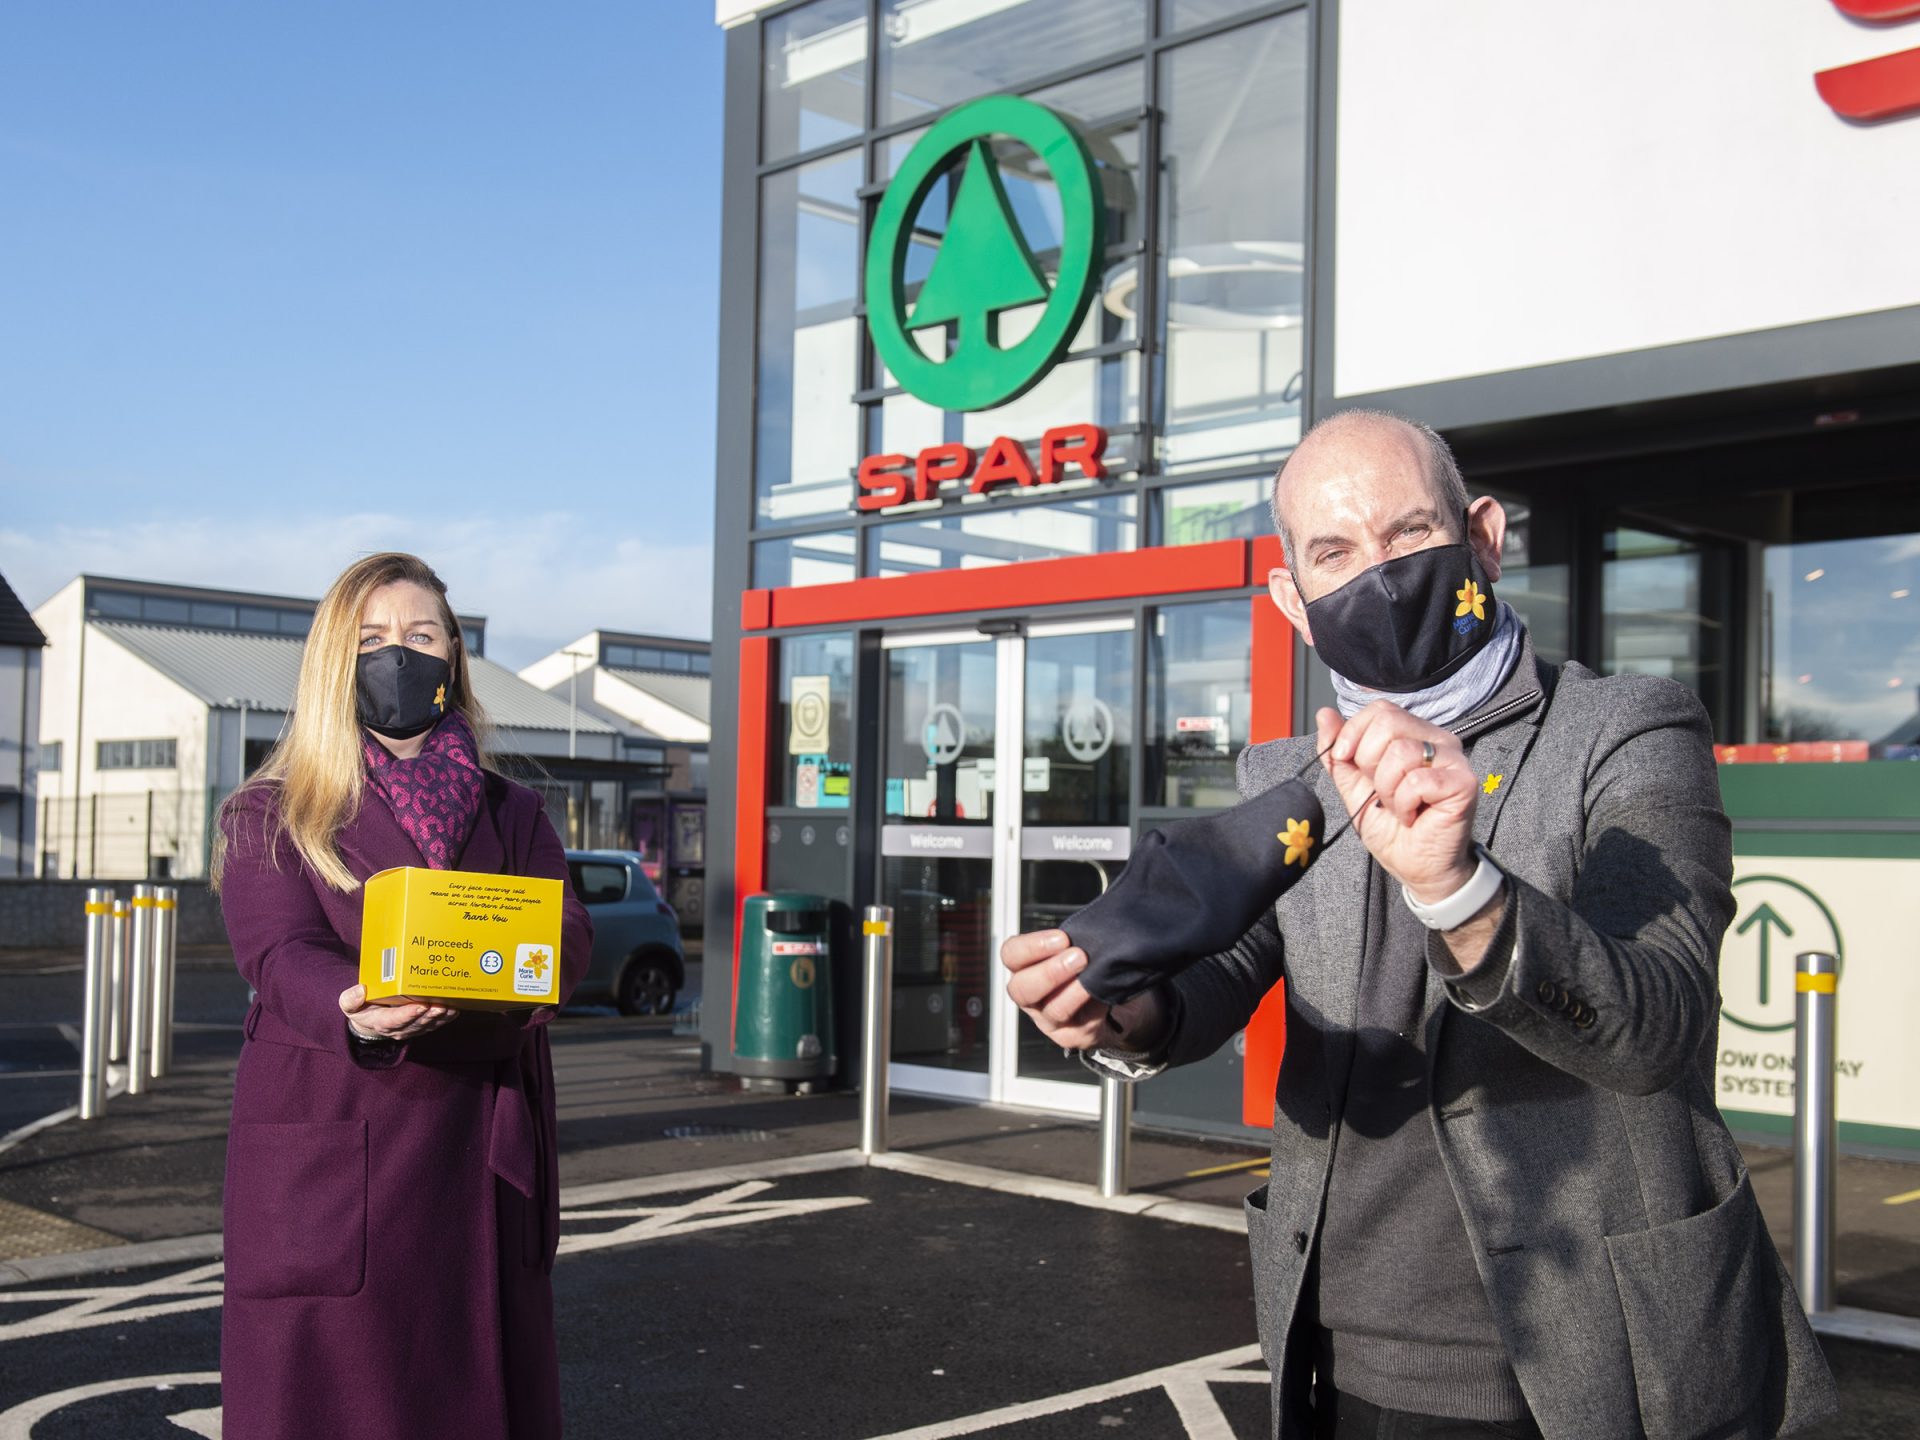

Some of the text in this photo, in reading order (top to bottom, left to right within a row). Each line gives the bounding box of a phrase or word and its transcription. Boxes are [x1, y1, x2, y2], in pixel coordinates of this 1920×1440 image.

[857, 423, 1106, 510] SPAR
[910, 833, 964, 849] Welcome
[1052, 835, 1113, 851] Welcome
[448, 883, 467, 891] Every
[462, 911, 509, 923] Thank You
[411, 936, 474, 950] All proceeds
[428, 953, 456, 964] go to
[484, 955, 499, 968] £3
[410, 965, 472, 978] Marie Curie.
[1719, 1049, 1864, 1079] OW ON AY
